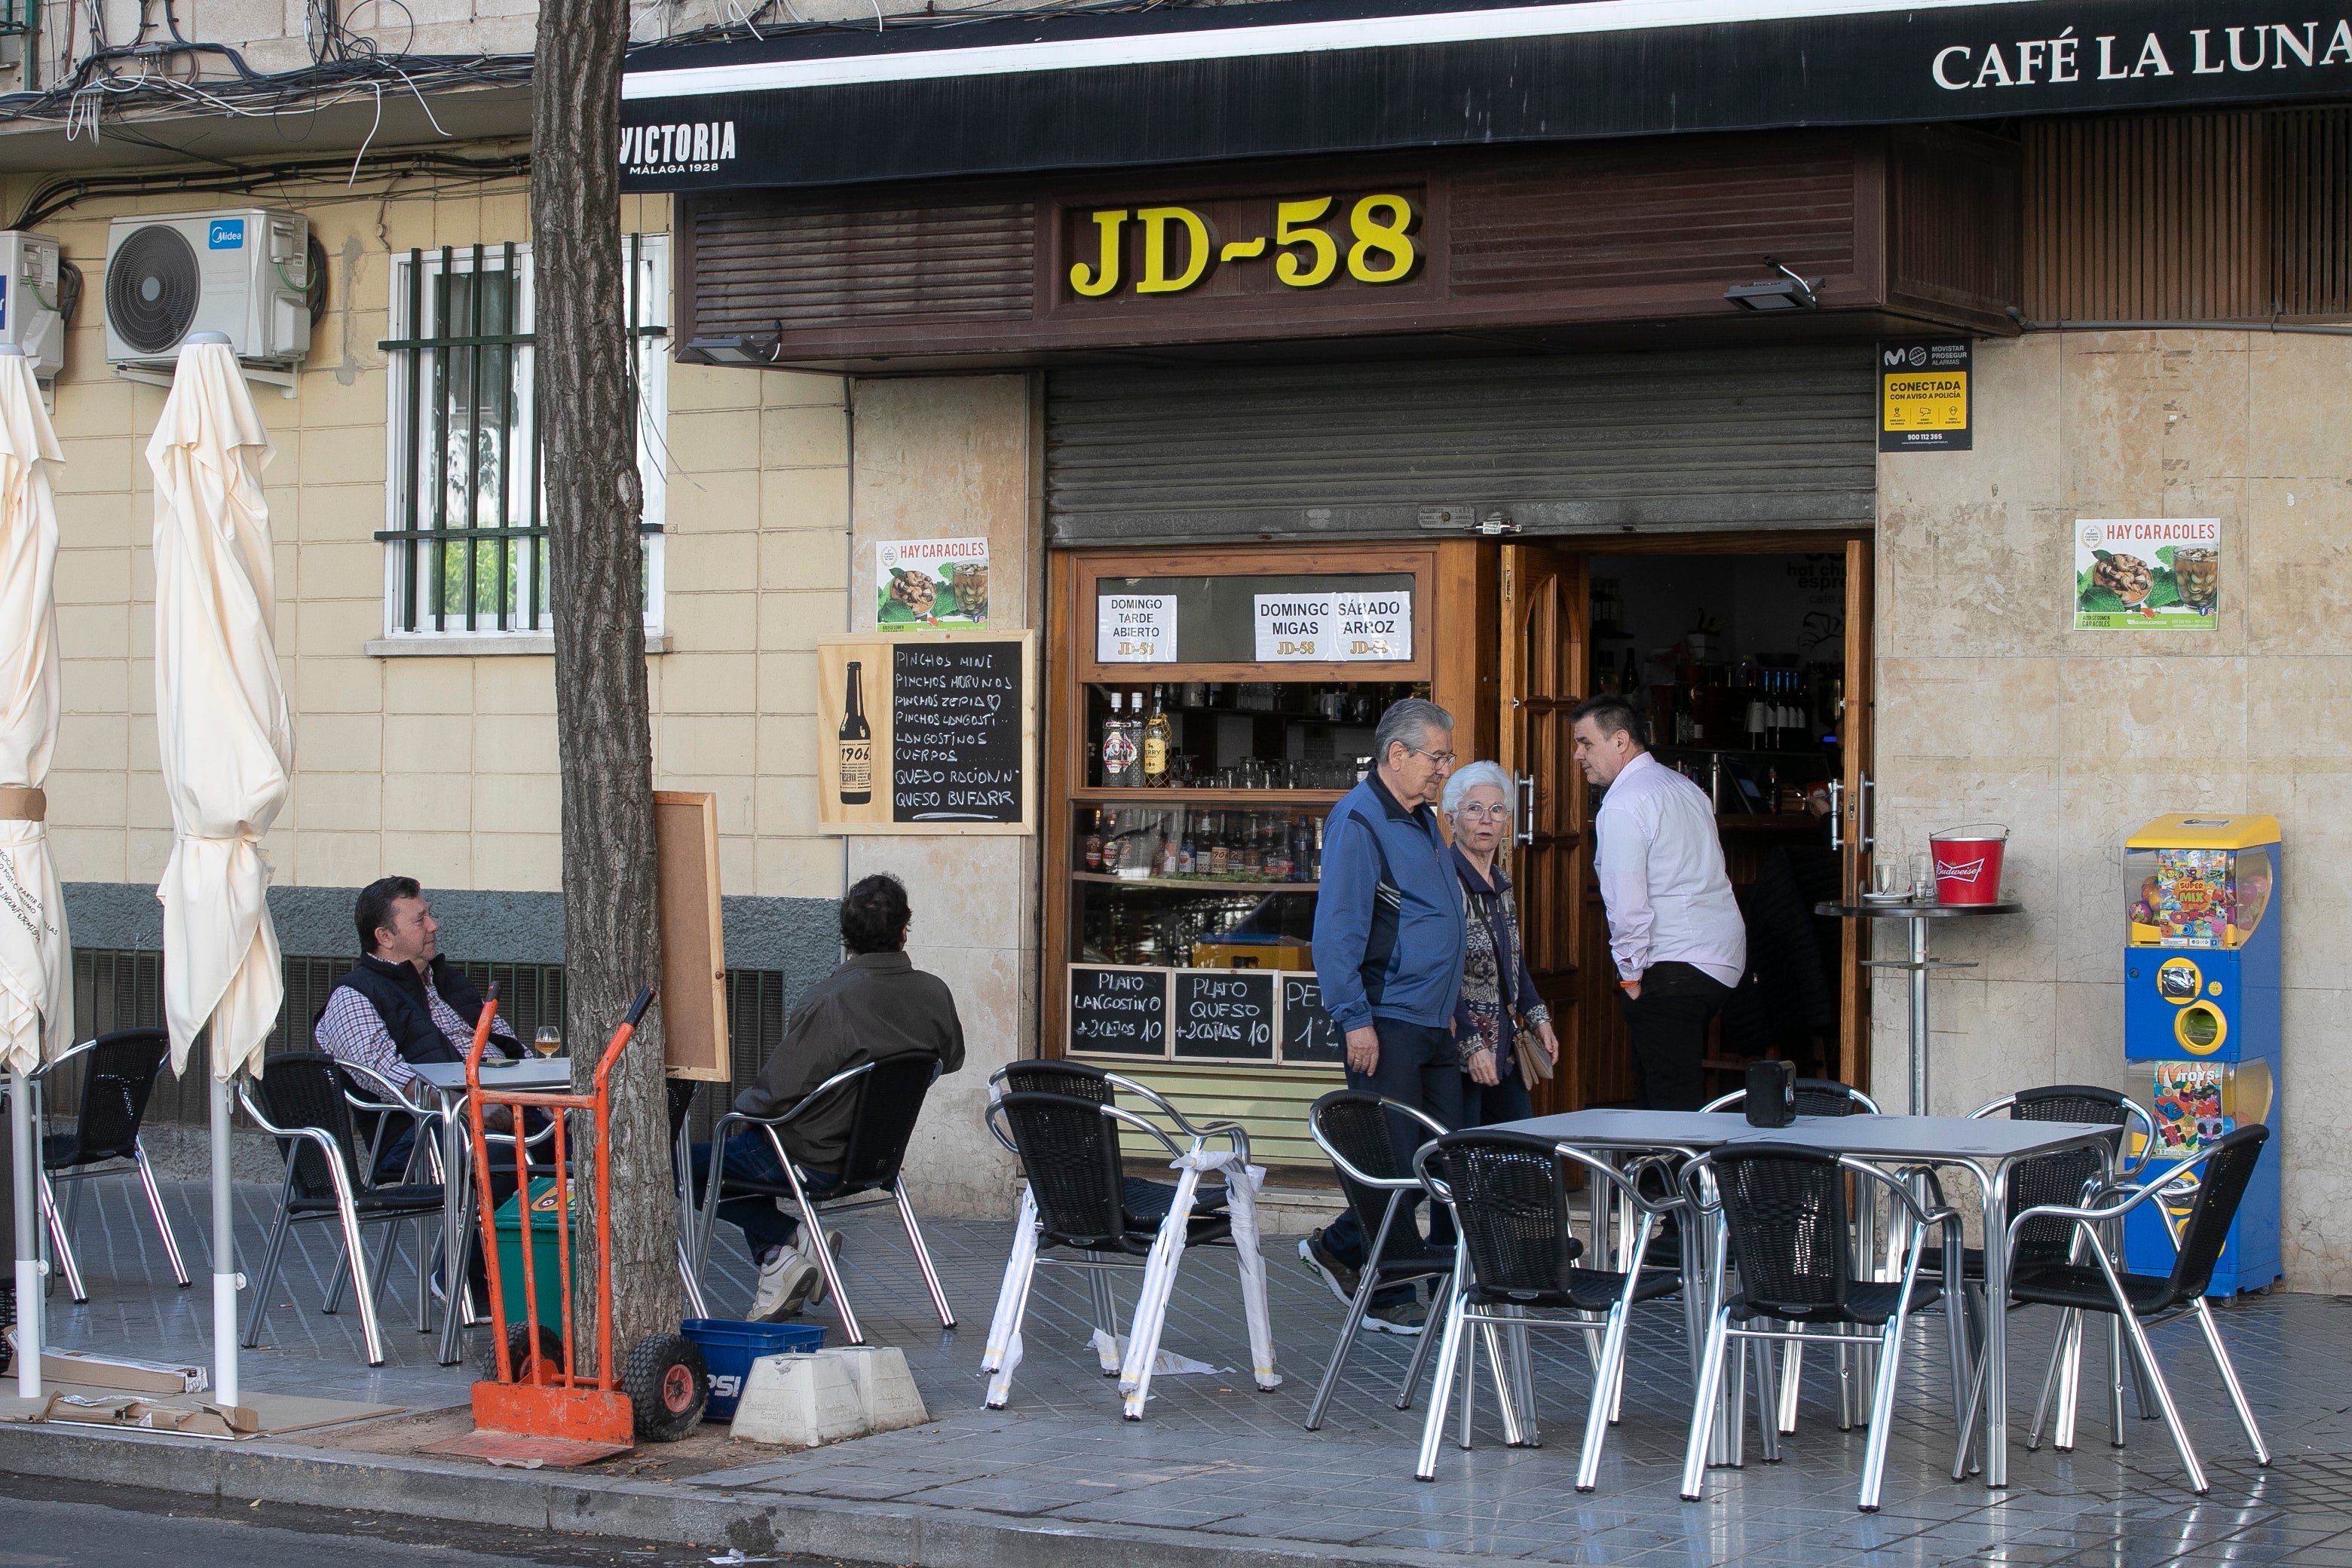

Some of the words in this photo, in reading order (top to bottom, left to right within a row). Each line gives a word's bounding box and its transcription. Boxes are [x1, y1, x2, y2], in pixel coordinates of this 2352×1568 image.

[1932, 26, 2079, 90] CAFÉ
[2096, 32, 2173, 80] LA
[2190, 19, 2352, 74] LUNA
[620, 121, 735, 164] VICTORIA
[629, 164, 685, 174] MÁLAGA
[690, 164, 718, 173] 1928
[212, 228, 242, 243] Midea
[1890, 381, 1961, 391] CONECTADA
[1934, 390, 1961, 399] POLICÍA
[2106, 525, 2132, 540] HAY
[2135, 524, 2215, 540] CARACOLES
[901, 545, 920, 559] HAY
[922, 542, 985, 558] CARACOLES
[1787, 562, 1814, 576] hot
[1111, 599, 1162, 609] DOMINGO
[1260, 603, 1328, 617] DOMINGO
[1338, 599, 1400, 615] SÁBADO
[1119, 614, 1153, 623] TARDE
[1113, 627, 1159, 637] ABIERTO
[1272, 622, 1318, 635] MIGAS
[1343, 620, 1395, 634] ARROZ
[1277, 642, 1315, 654] JD-58
[896, 651, 951, 667] PINCHOS
[896, 673, 946, 688] PINCHOS
[951, 675, 1012, 689] MORUNOS
[895, 694, 939, 707] PINCHOS
[896, 712, 940, 725] PINCHOS
[841, 746, 870, 762] 1906
[896, 748, 957, 761] CUERPOS
[896, 768, 945, 784] QUESO
[896, 792, 941, 807] QUESO
[1935, 865, 1982, 875] Budweiser
[2179, 892, 2204, 902] MIX
[1098, 973, 1144, 991] PLATO
[1193, 978, 1248, 999] PLATO
[1287, 982, 1325, 1011] PE
[1190, 1001, 1260, 1018] QUESO
[1141, 1018, 1162, 1043] 10
[1248, 1020, 1270, 1047] 10
[2158, 1063, 2220, 1086] MIX
[2180, 1070, 2215, 1083] TOYS
[706, 1374, 742, 1398] PSI
